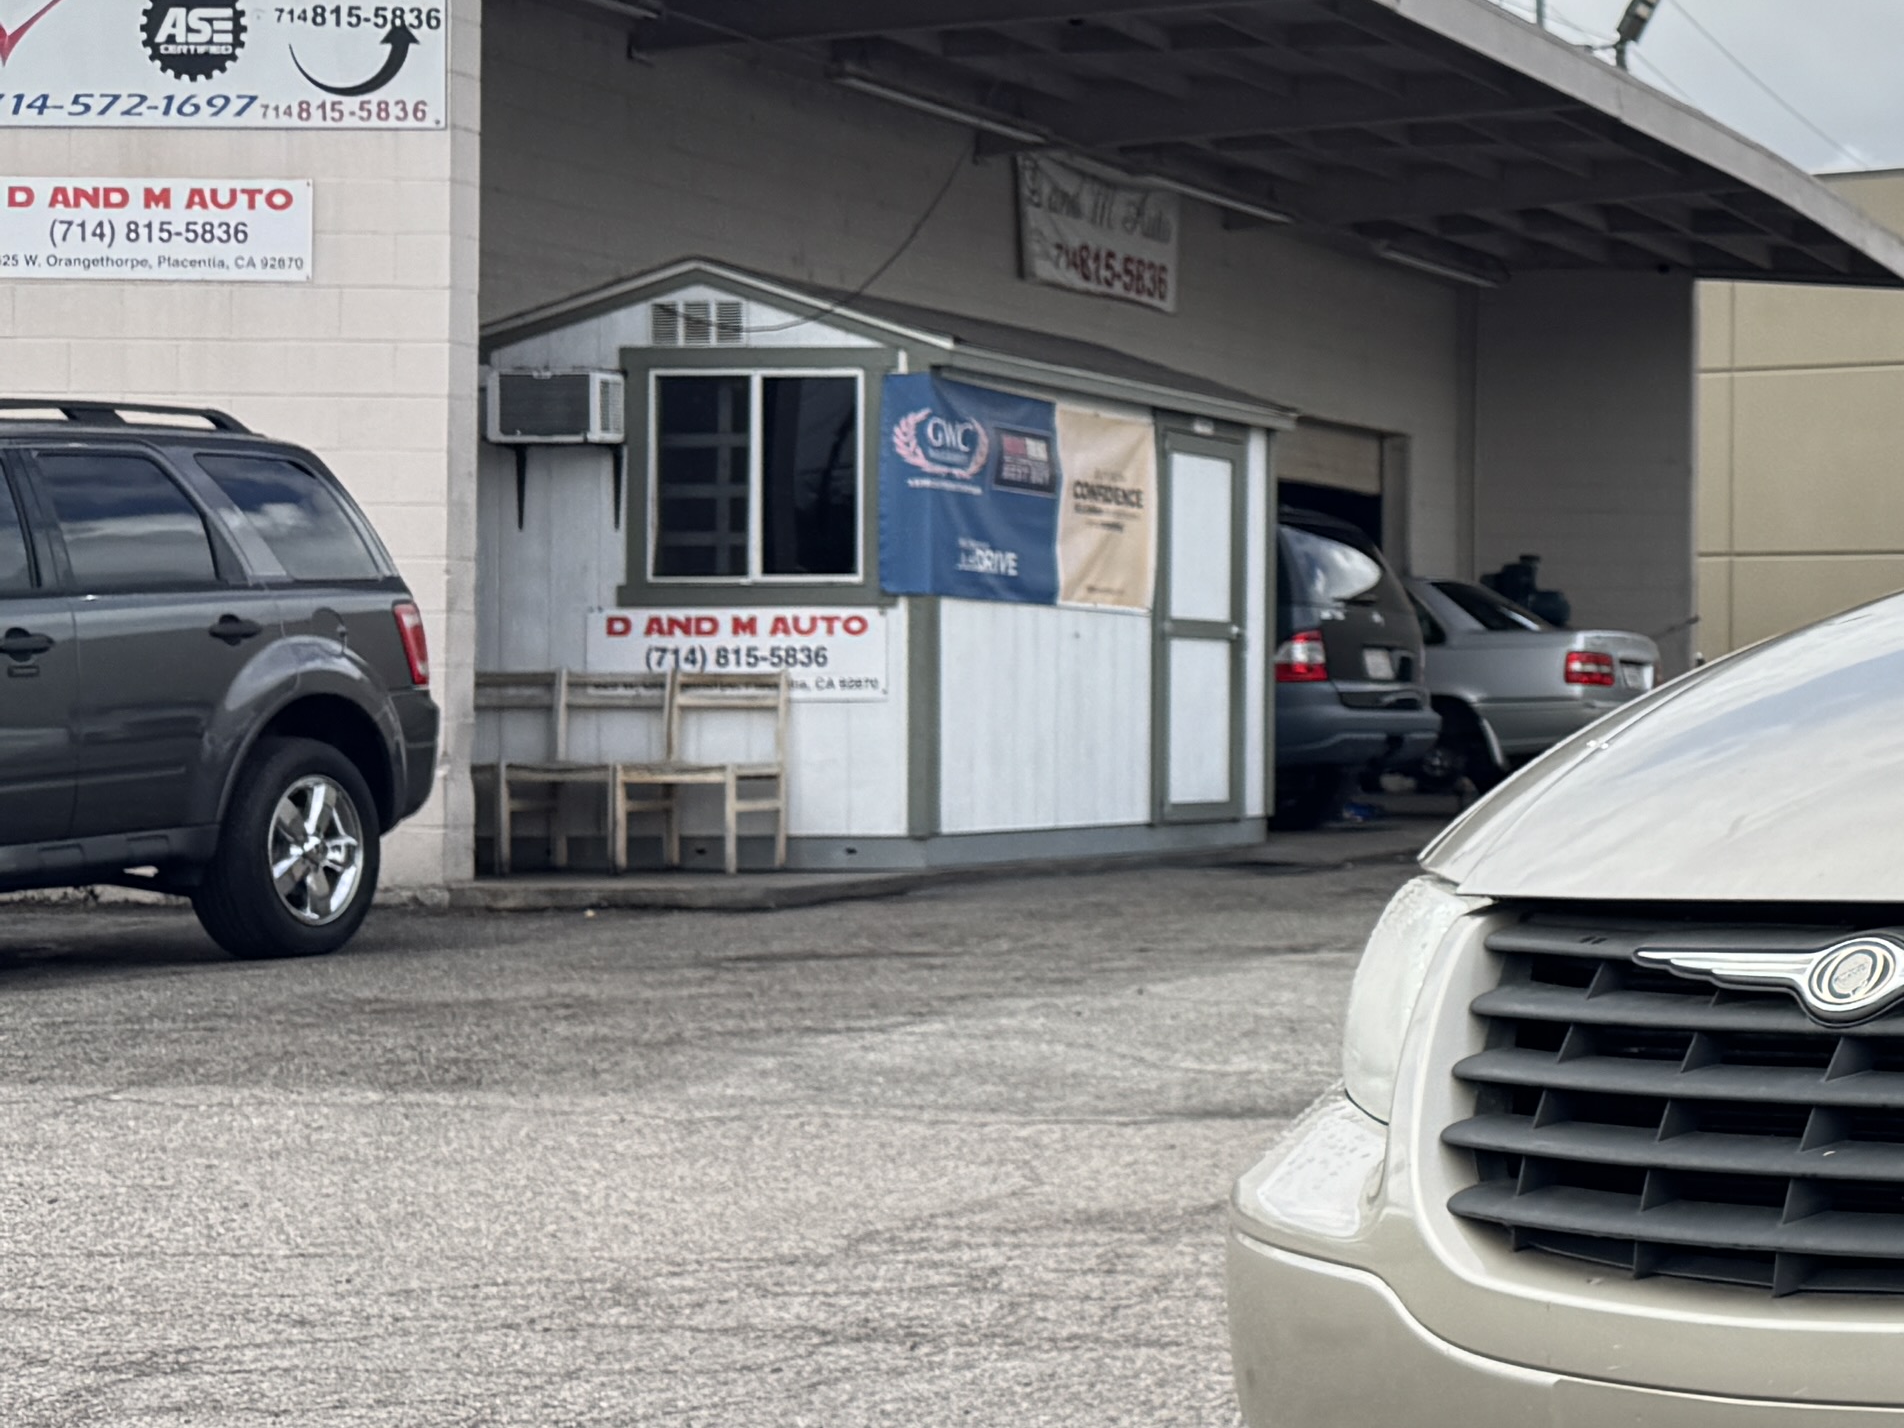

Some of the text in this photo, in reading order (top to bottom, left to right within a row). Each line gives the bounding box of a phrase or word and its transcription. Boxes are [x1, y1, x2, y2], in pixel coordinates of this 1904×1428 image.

[155, 7, 234, 43] ASE
[0, 93, 258, 117] 14-572-1697
[7, 186, 294, 211] D AND M AUTO
[49, 218, 249, 248] (714) 815-5836
[0, 253, 19, 267] 25
[24, 253, 41, 268] W.
[46, 253, 153, 271] Orangethorpe,
[157, 255, 230, 270] Placentia,
[234, 255, 256, 269] CA
[927, 417, 974, 452] GWC
[1073, 481, 1144, 509] CONFIDENCE
[606, 616, 868, 637] D AND M AUTO
[645, 645, 829, 673] (714) 815-5836
[815, 676, 836, 691] CA
